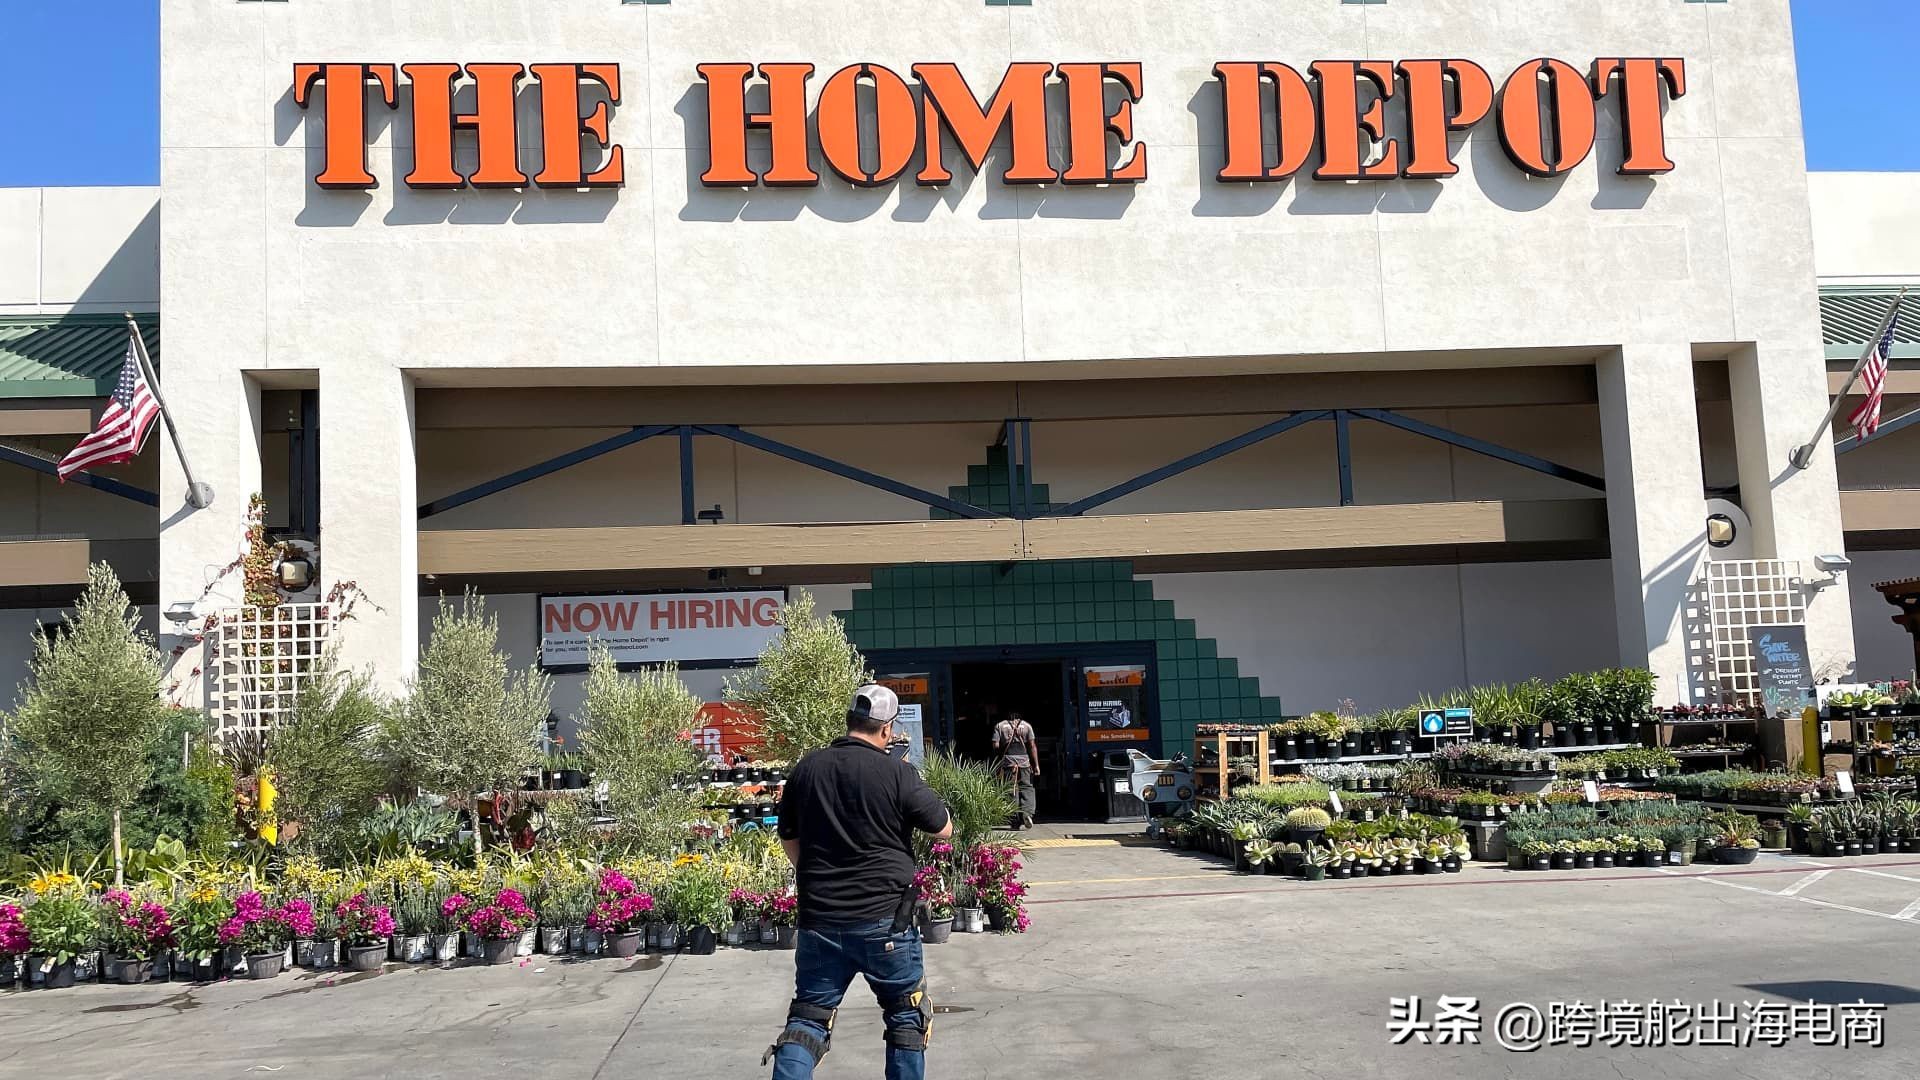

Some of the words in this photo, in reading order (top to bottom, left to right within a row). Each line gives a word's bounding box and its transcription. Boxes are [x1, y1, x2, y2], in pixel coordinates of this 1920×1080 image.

[293, 62, 625, 188] THE
[696, 61, 1147, 188] HOME
[1212, 57, 1686, 183] DEPOT
[544, 602, 640, 633] NOW
[650, 597, 782, 630] HIRING
[1767, 652, 1801, 663] WATER
